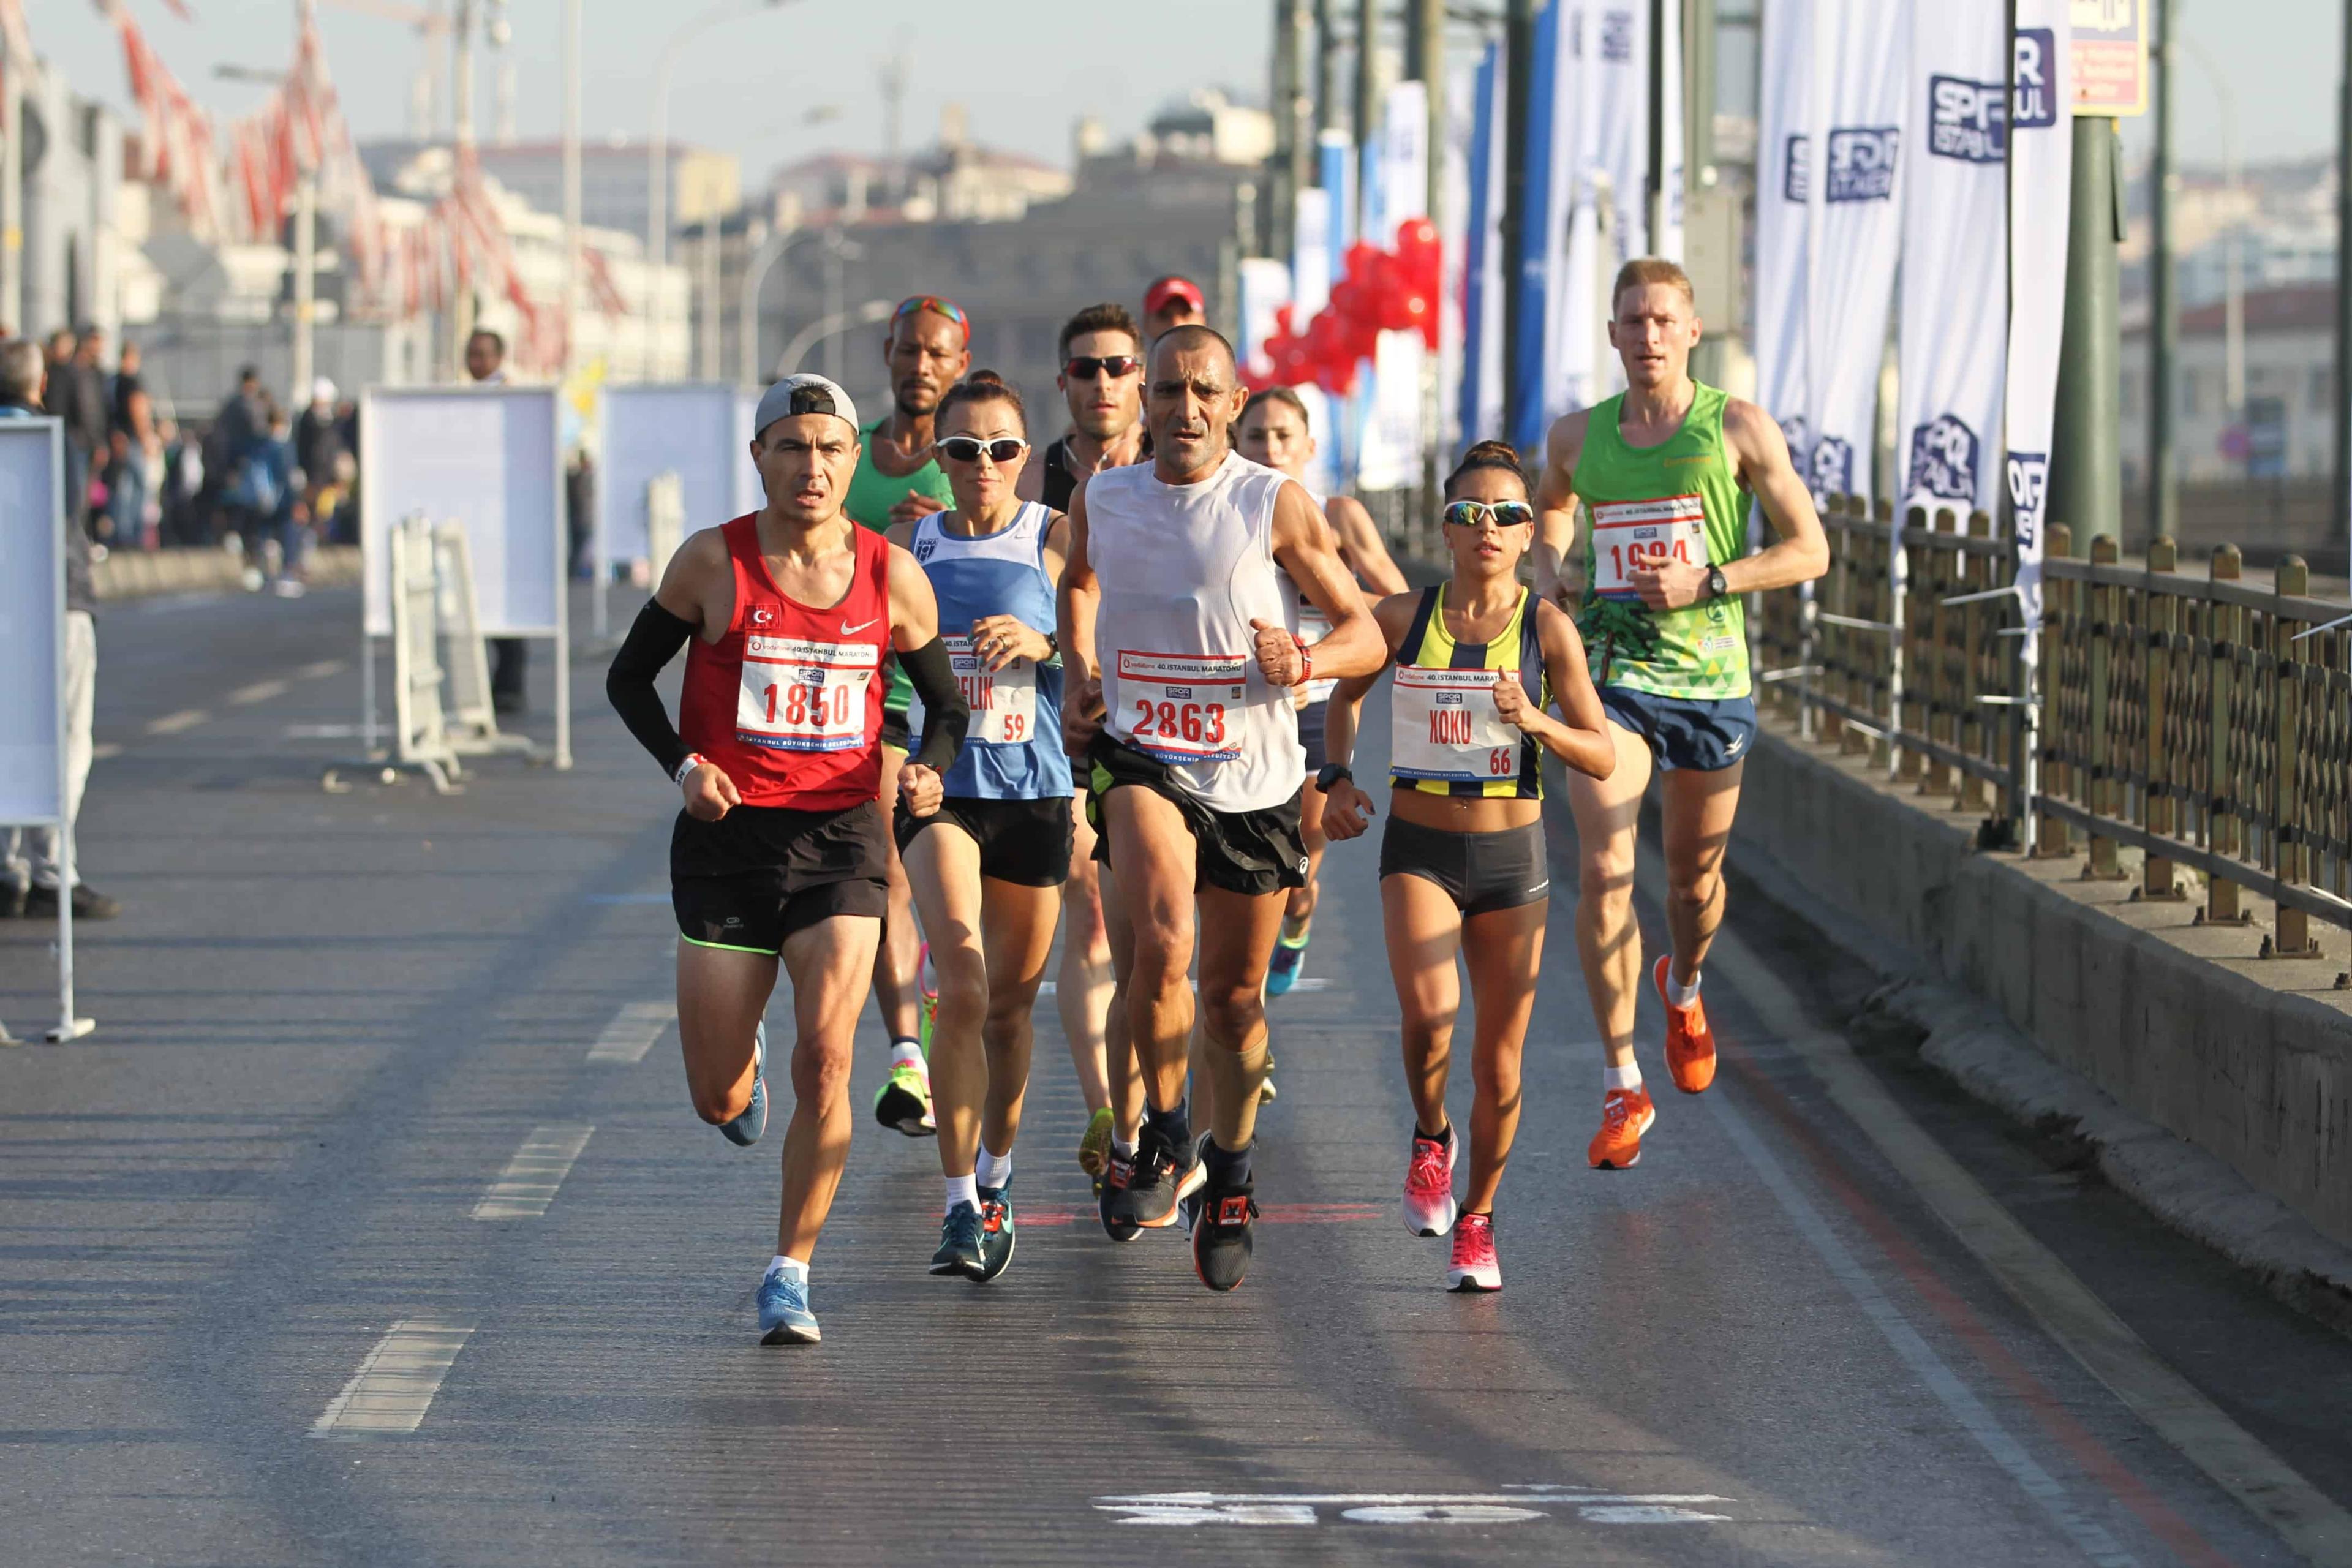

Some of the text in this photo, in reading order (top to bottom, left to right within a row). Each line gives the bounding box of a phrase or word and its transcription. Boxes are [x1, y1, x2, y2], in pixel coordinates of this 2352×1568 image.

[2013, 87, 2048, 120] UL
[764, 684, 849, 726] 1850
[1133, 699, 1225, 743] 2863
[1004, 714, 1025, 741] 59
[1430, 710, 1472, 744] XOKU
[1490, 747, 1511, 775] 66
